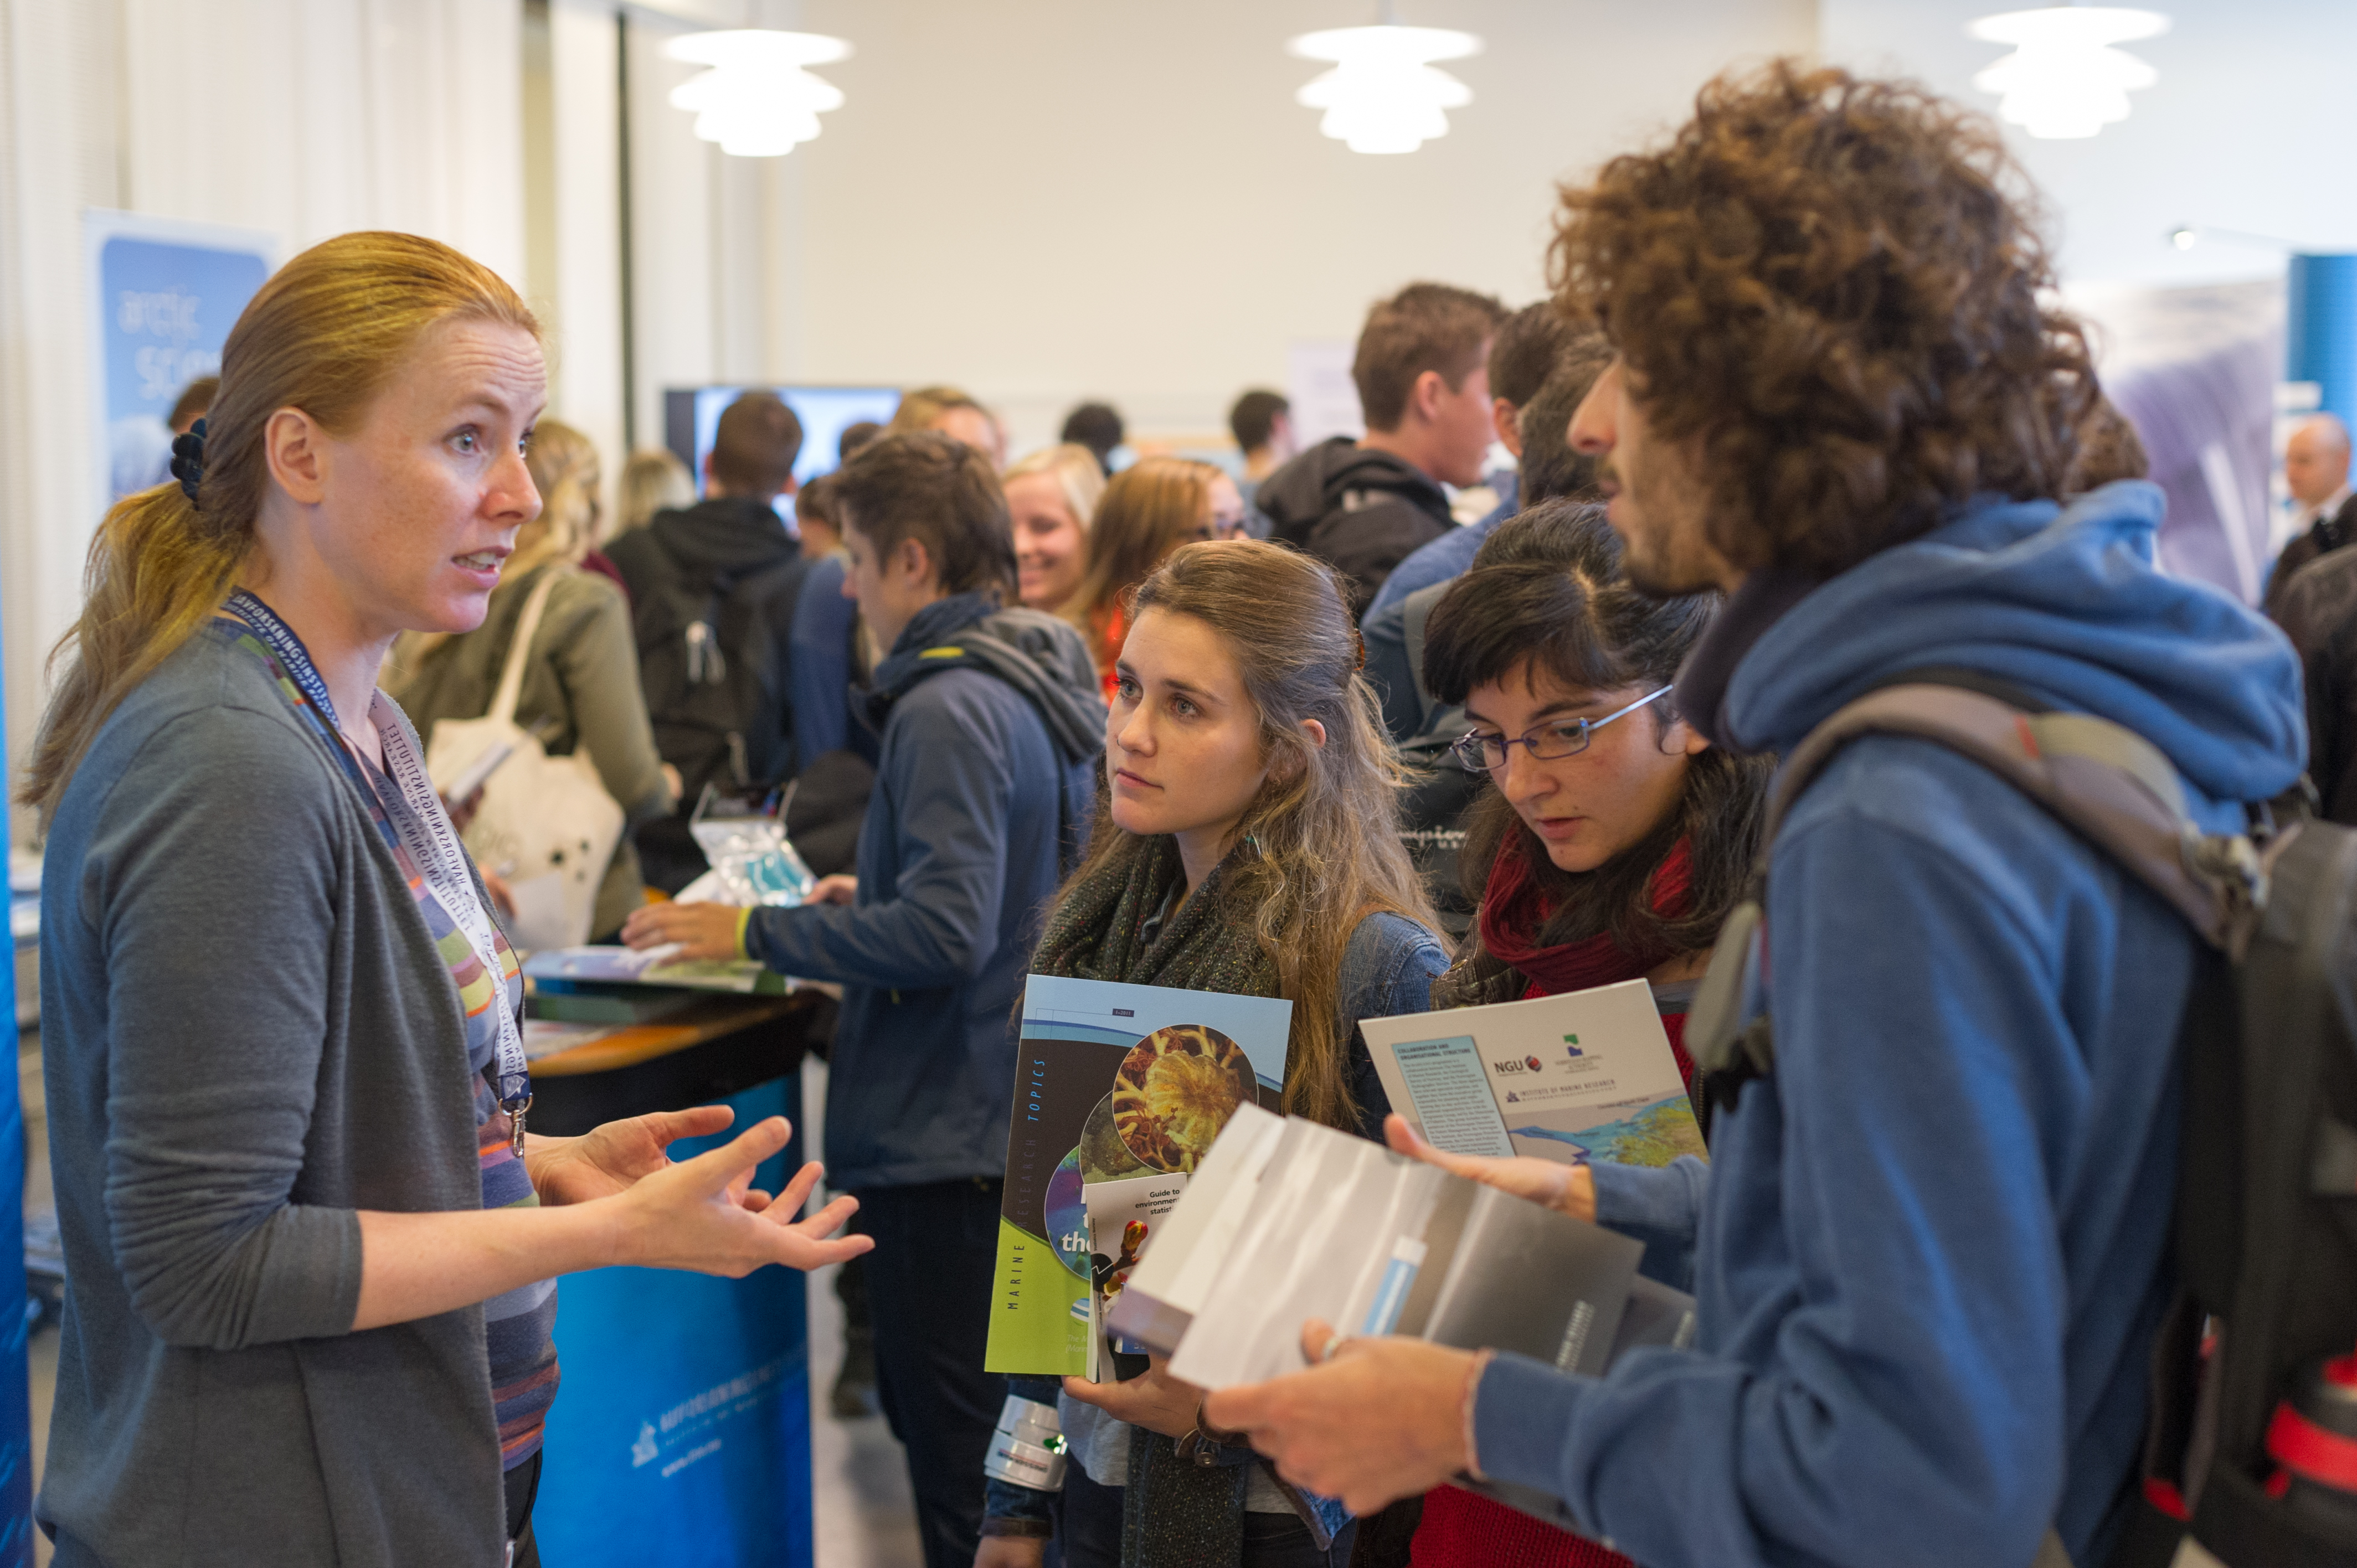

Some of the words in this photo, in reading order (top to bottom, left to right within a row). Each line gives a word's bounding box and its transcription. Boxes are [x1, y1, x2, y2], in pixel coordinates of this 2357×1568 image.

[265, 635, 279, 648] OF
[277, 649, 310, 687] MARINE
[1494, 1060, 1523, 1073] NGU
[1007, 1245, 1025, 1310] MARINE
[1017, 1139, 1036, 1227] RESEARCH
[1027, 1059, 1045, 1121] TOPICS
